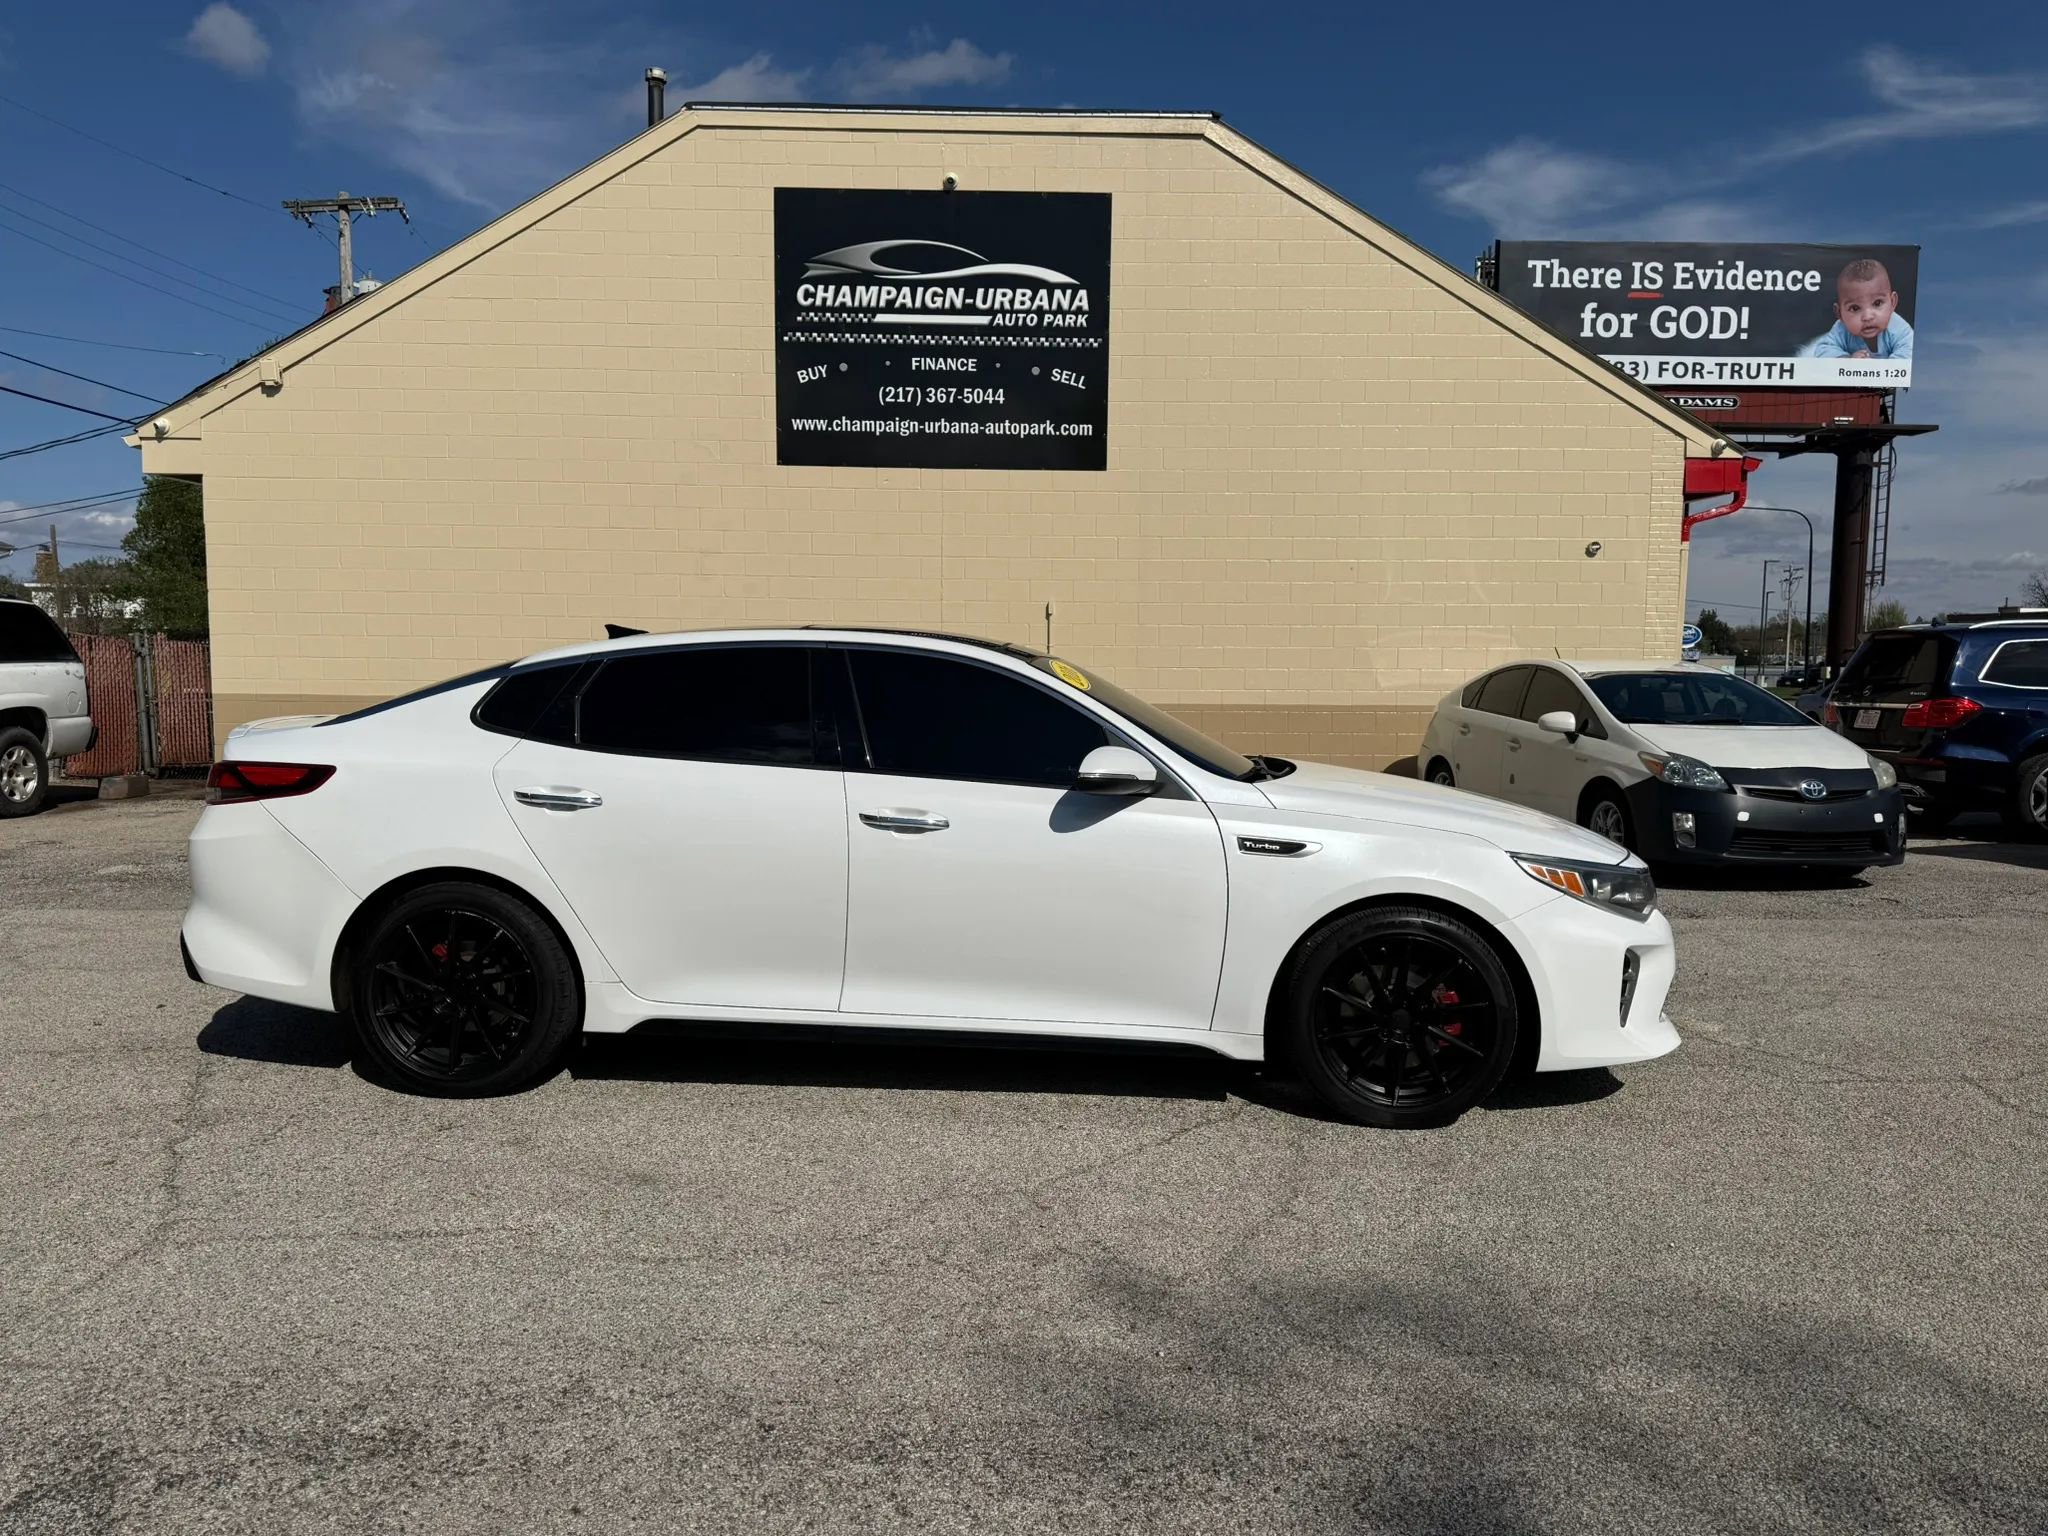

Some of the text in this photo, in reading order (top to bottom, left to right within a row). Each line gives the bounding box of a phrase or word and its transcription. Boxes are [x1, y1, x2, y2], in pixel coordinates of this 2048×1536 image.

[1527, 258, 1822, 291] There IS Evidence
[796, 283, 1090, 312] CHAMPAIGN-URBANA
[992, 313, 1089, 328] AUTO PARK
[1580, 302, 1750, 340] for GOD!
[796, 364, 828, 384] BUY
[911, 357, 978, 372] FINANCE
[1657, 360, 1795, 380] FOR-TRUTH
[1838, 367, 1907, 378] Romans 1:20
[1050, 367, 1087, 390] SELL
[878, 386, 1005, 406] (217) 367-5044
[791, 416, 1093, 438] www.champaign-urbana-autopark.com
[1243, 841, 1280, 850] Turbo
